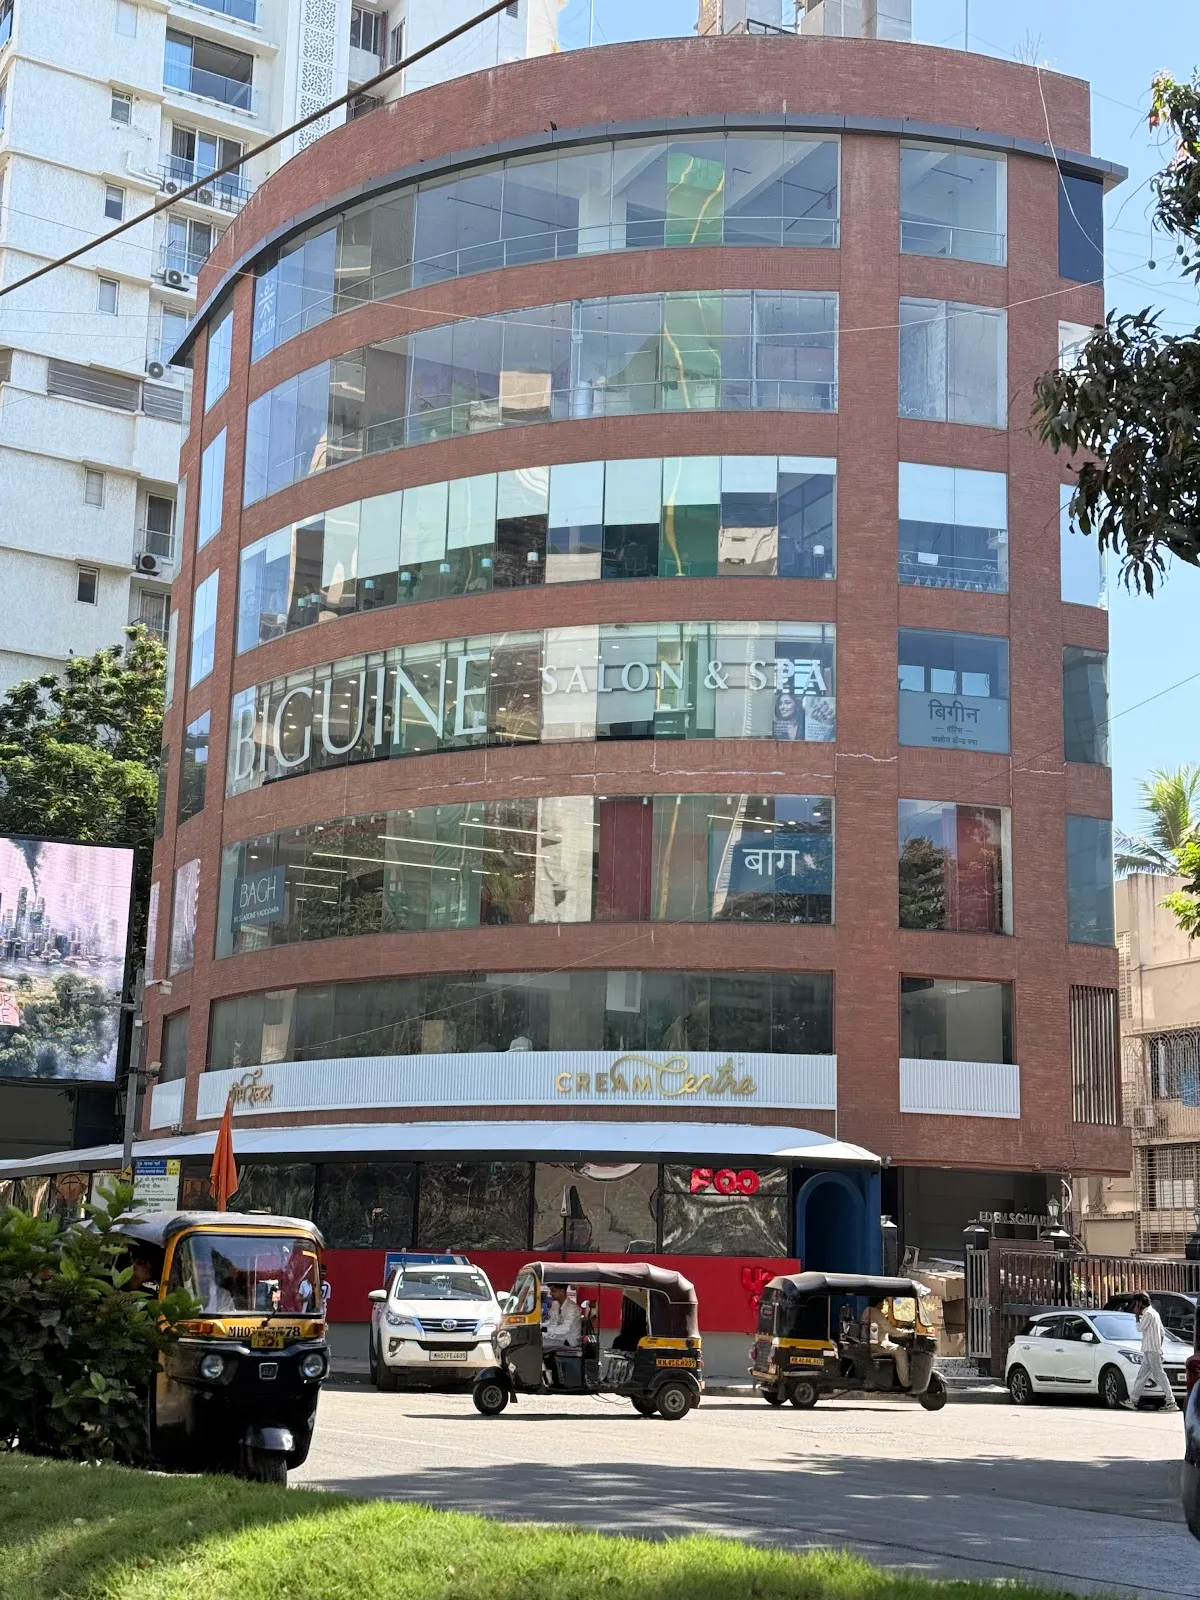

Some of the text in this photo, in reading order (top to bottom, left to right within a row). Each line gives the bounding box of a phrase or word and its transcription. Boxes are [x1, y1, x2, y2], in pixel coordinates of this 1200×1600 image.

[541, 659, 827, 695] SALON & SPA
[235, 653, 490, 781] BIGUINE
[928, 698, 980, 723] बिगीन
[742, 848, 800, 876] बाग
[555, 1055, 757, 1096] CREAM Centre
[690, 1167, 761, 1196] FOO
